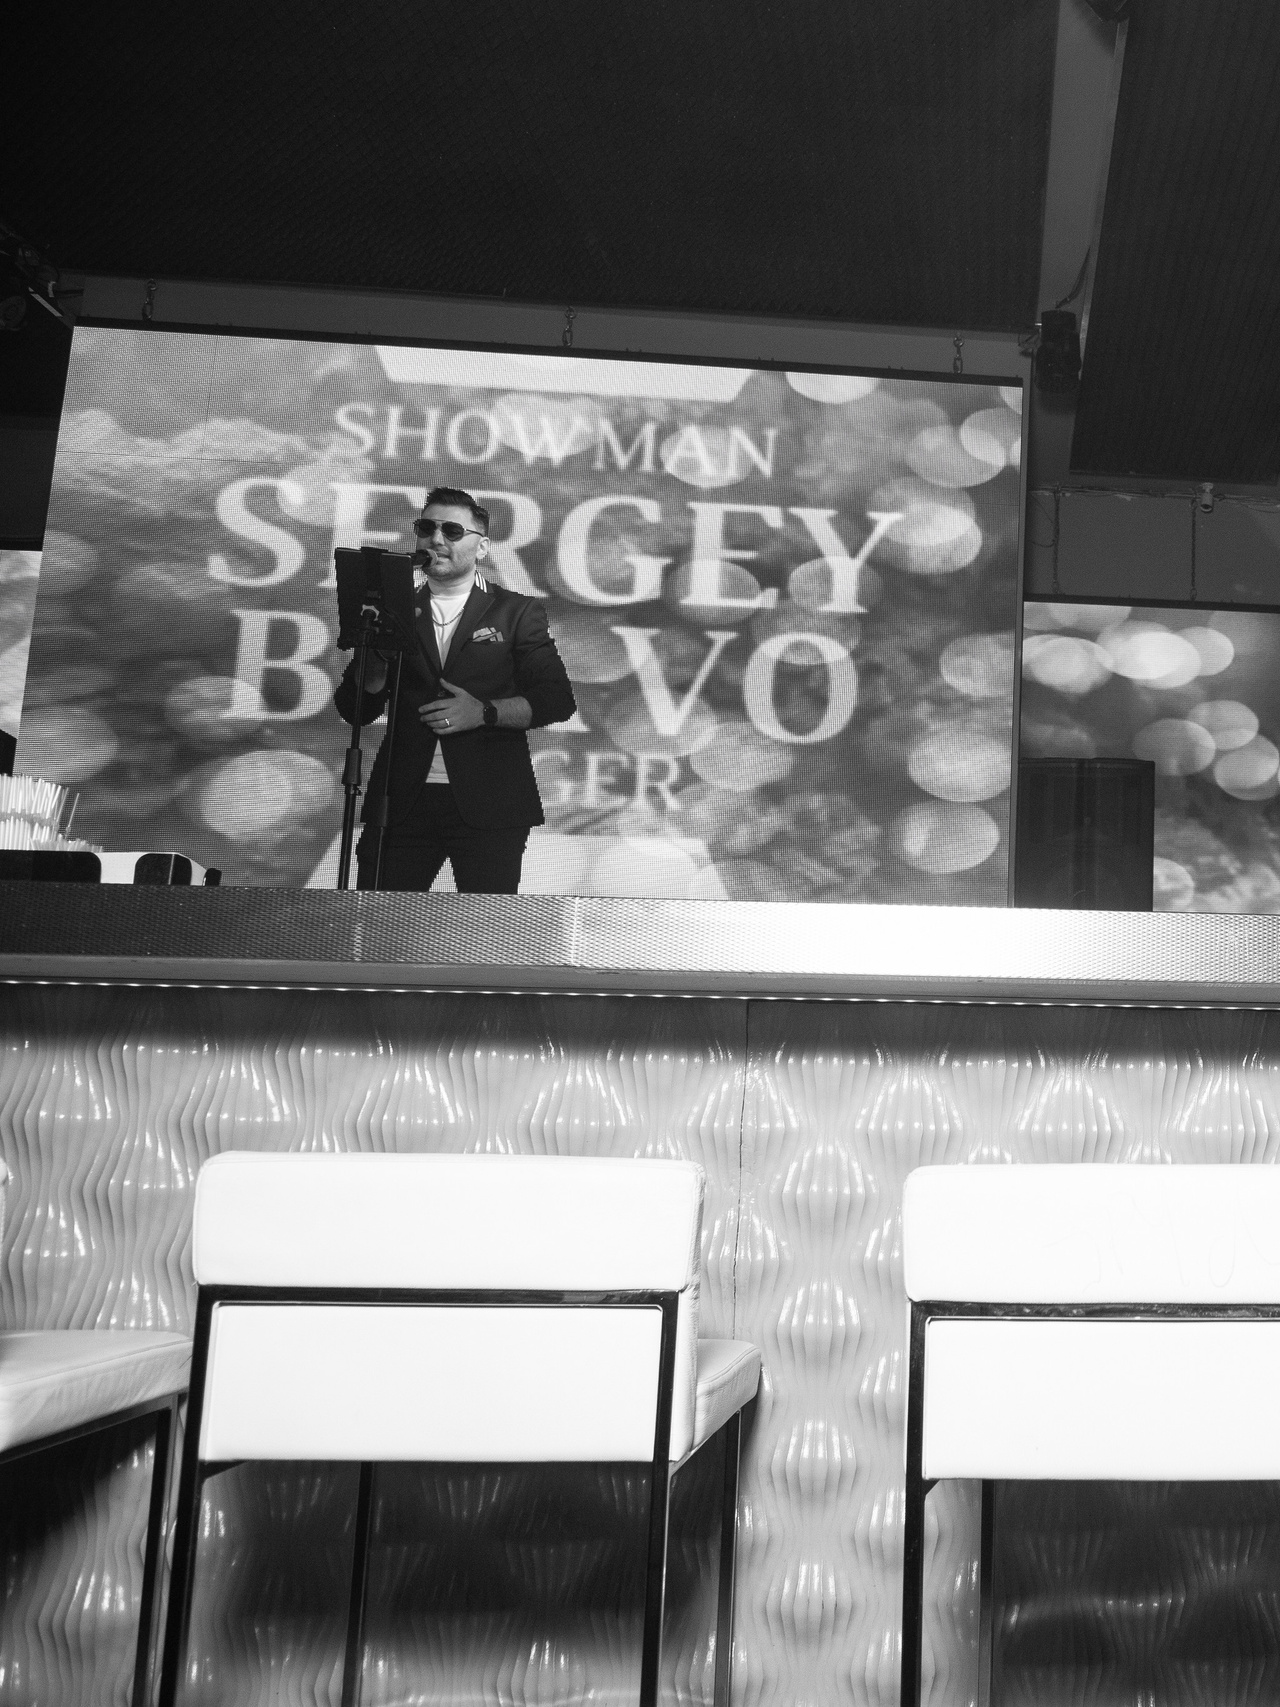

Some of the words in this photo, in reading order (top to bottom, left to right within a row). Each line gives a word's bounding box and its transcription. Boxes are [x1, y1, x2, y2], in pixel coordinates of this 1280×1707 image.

[334, 401, 778, 479] SHOWMAN
[207, 477, 904, 613] SERGEY
[218, 609, 858, 744] BVO
[531, 749, 680, 812] GER
